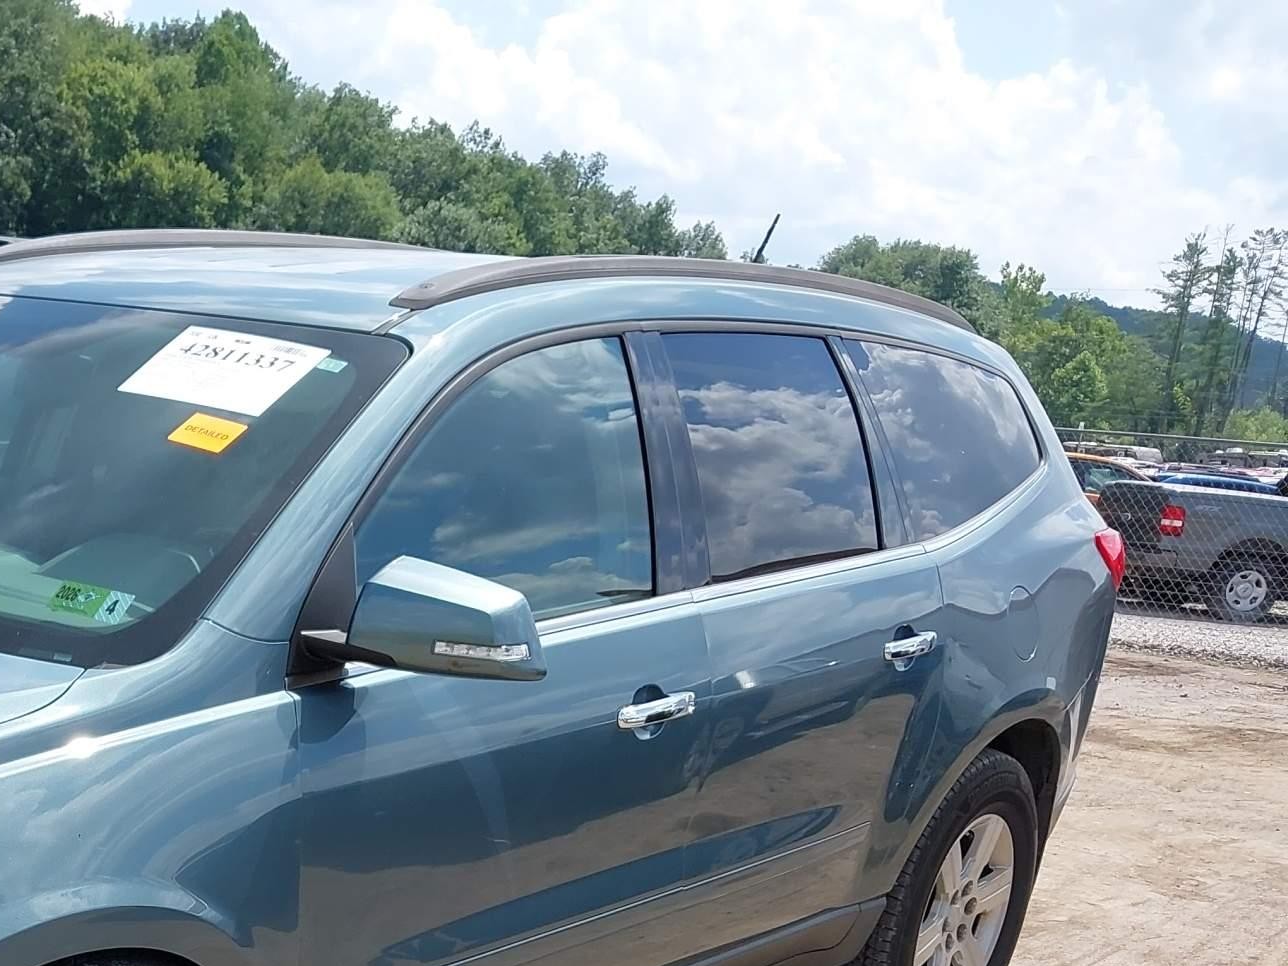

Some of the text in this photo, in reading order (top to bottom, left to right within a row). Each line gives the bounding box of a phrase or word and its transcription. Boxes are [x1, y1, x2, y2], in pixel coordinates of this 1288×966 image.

[180, 342, 297, 372] 42811337
[184, 424, 230, 441] DETAILED
[55, 584, 82, 602] 2026
[104, 599, 120, 615] 4
